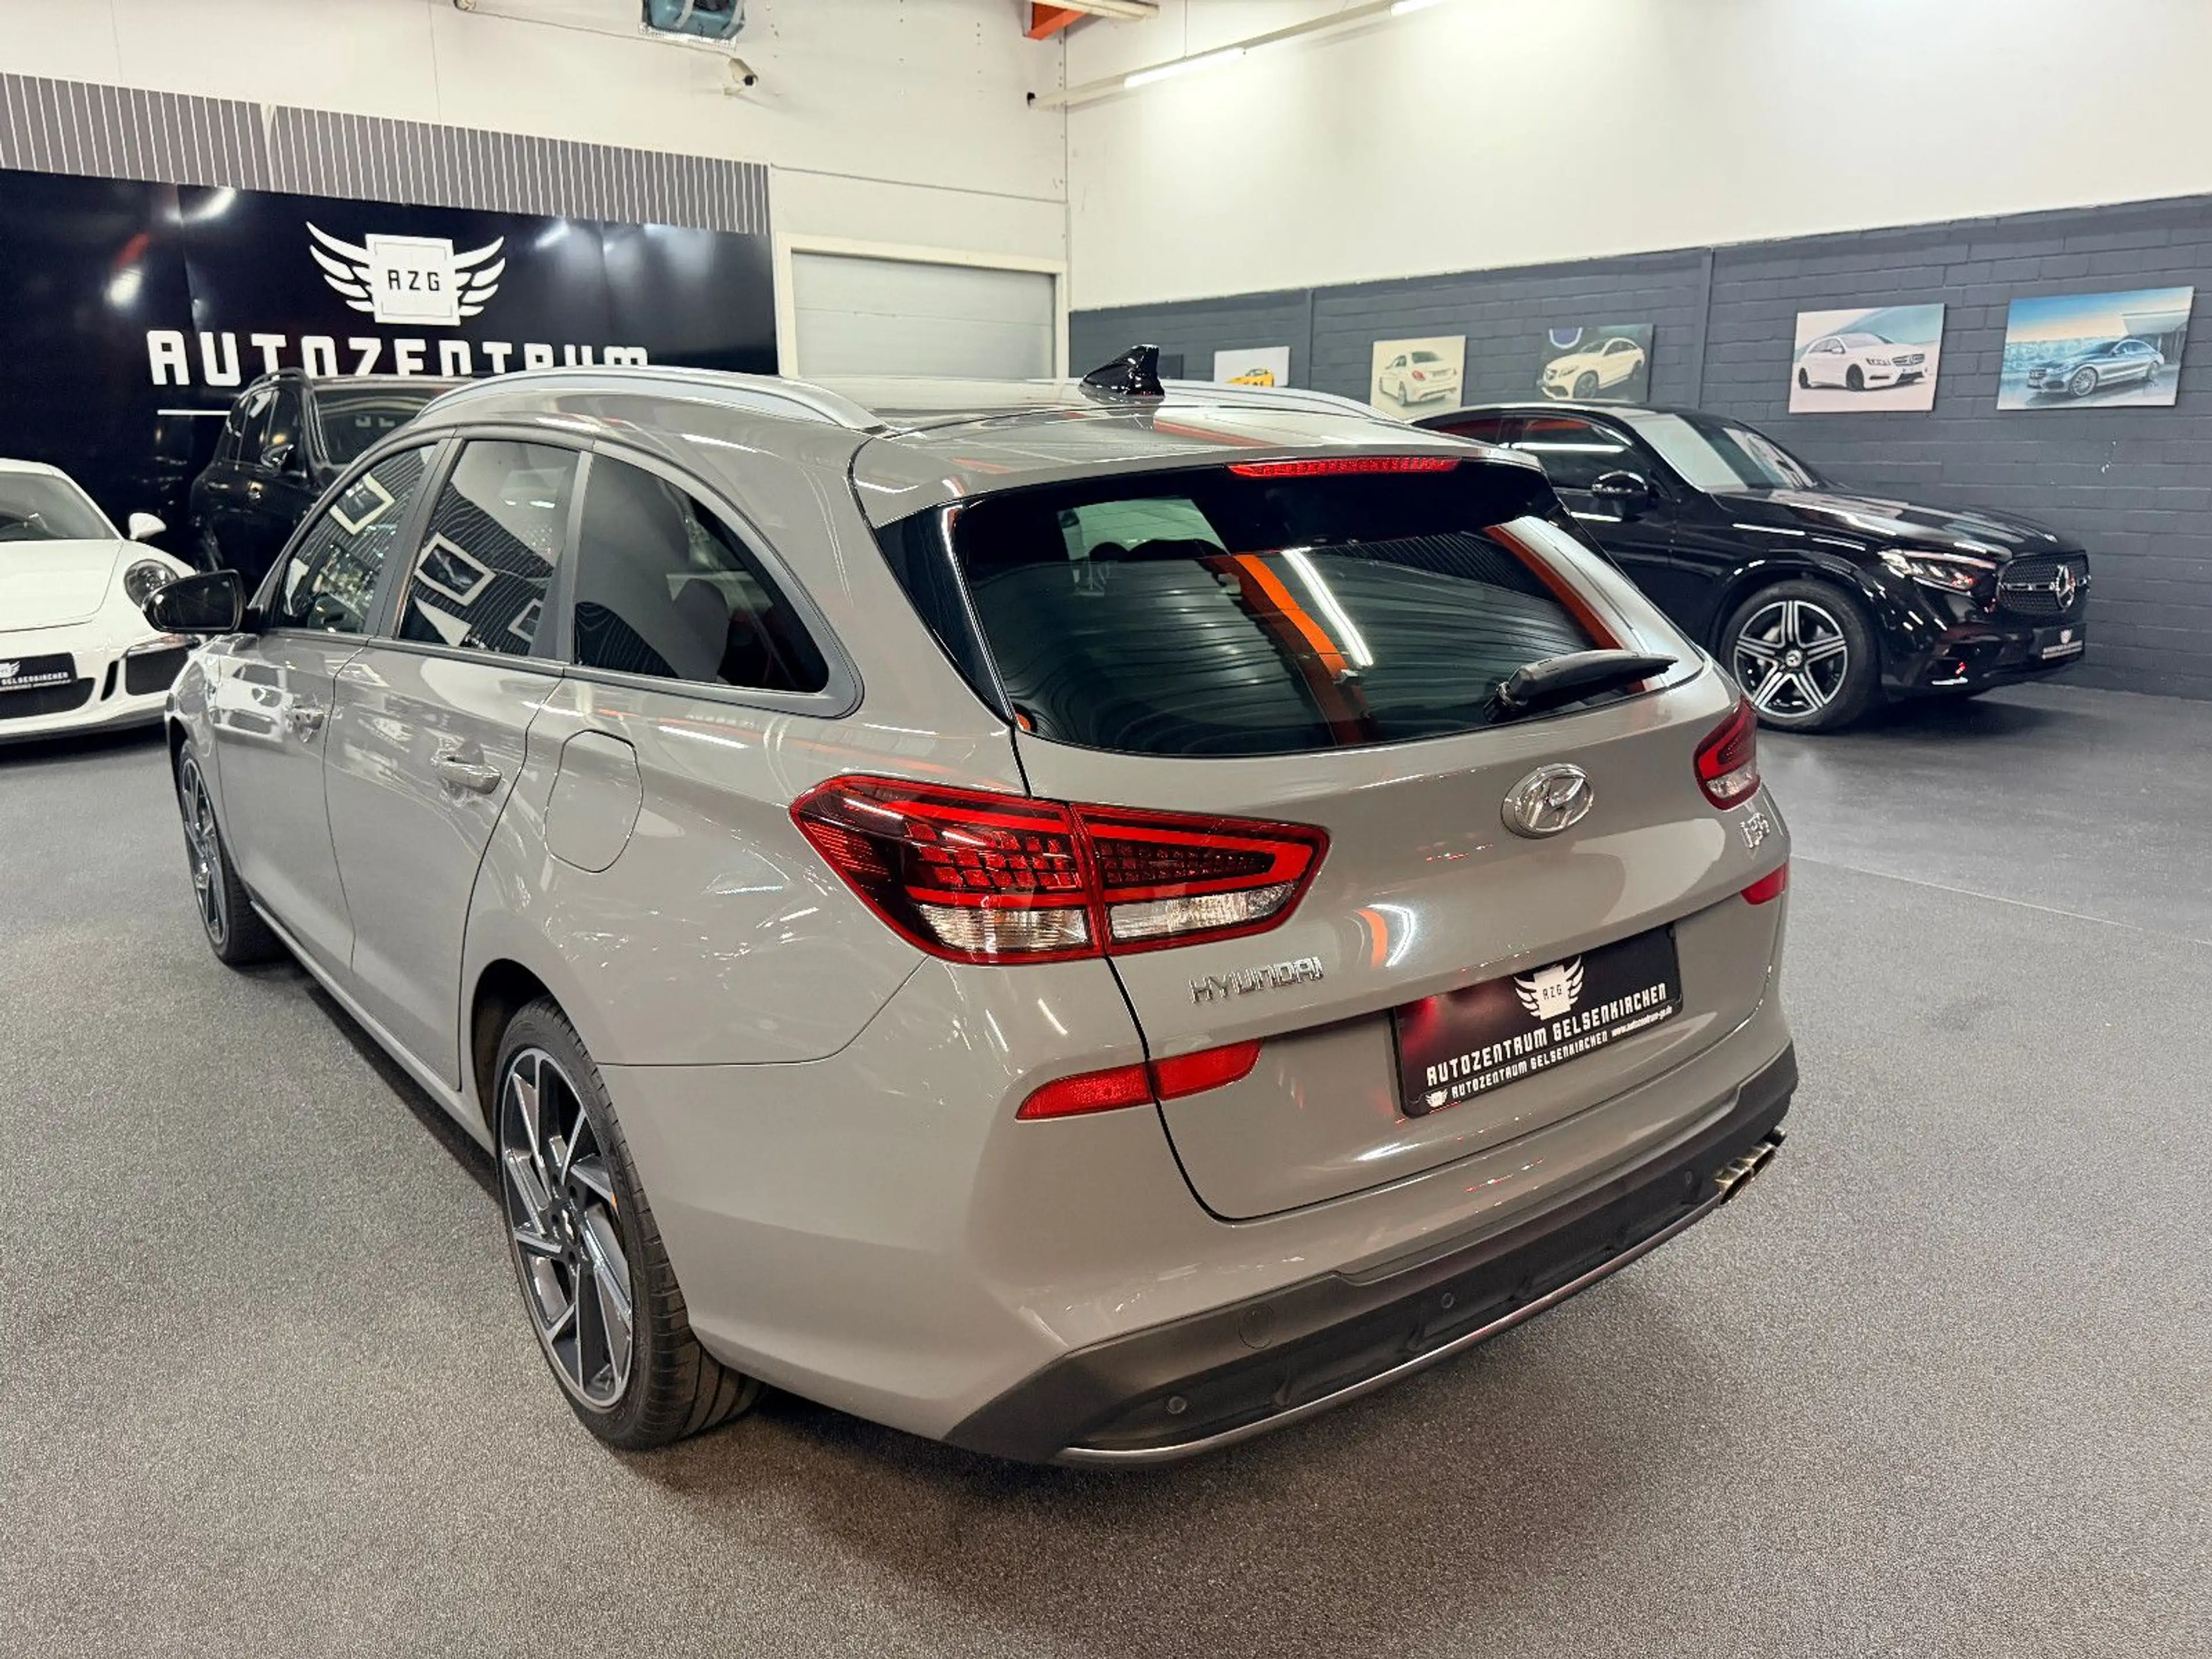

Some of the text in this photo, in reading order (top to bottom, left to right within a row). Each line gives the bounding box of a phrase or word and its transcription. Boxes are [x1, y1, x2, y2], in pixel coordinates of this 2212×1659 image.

[387, 269, 440, 291] AZG
[1188, 956, 1324, 1003] HYUNDAI
[1543, 984, 1562, 1000] AZG
[1426, 983, 1666, 1086] AUTOZENTRUM GELSENKIRCHEN
[1451, 1060, 1527, 1099] AUTOZENTRUM
[1530, 1030, 1608, 1070] GELSENKIRCHEN
